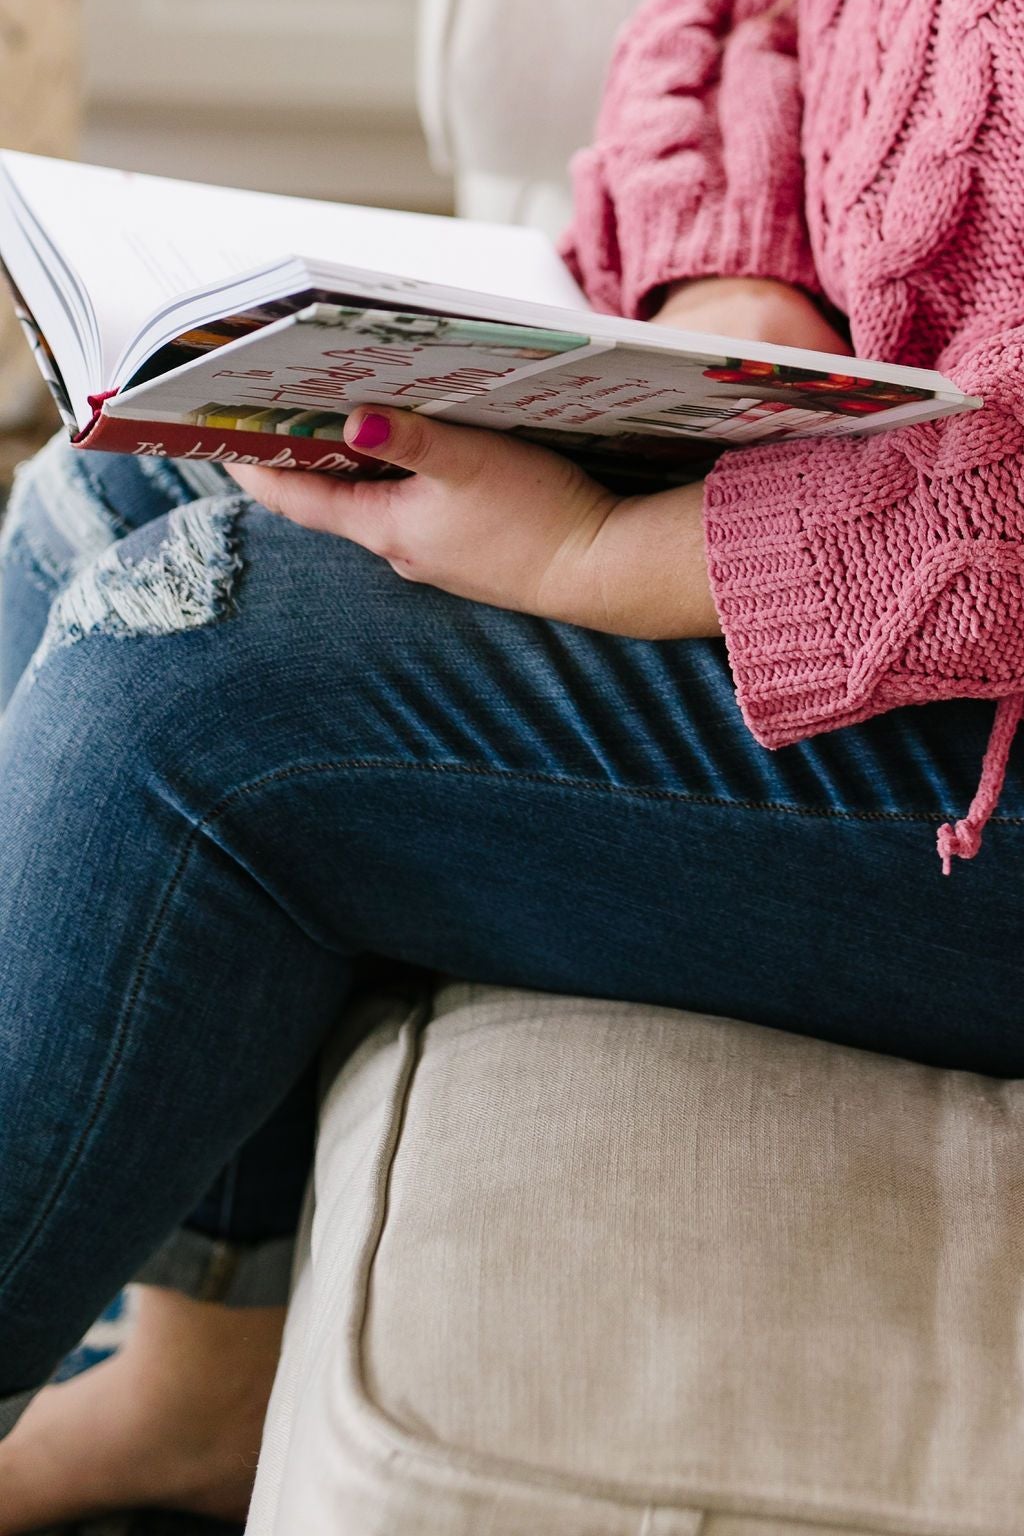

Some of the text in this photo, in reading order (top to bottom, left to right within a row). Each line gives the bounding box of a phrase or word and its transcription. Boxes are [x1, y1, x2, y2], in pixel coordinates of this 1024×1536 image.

[212, 369, 275, 381] The
[232, 346, 424, 408] Hands-On
[362, 367, 515, 404] Home
[132, 441, 168, 457] The
[174, 441, 359, 471] Hands-On
